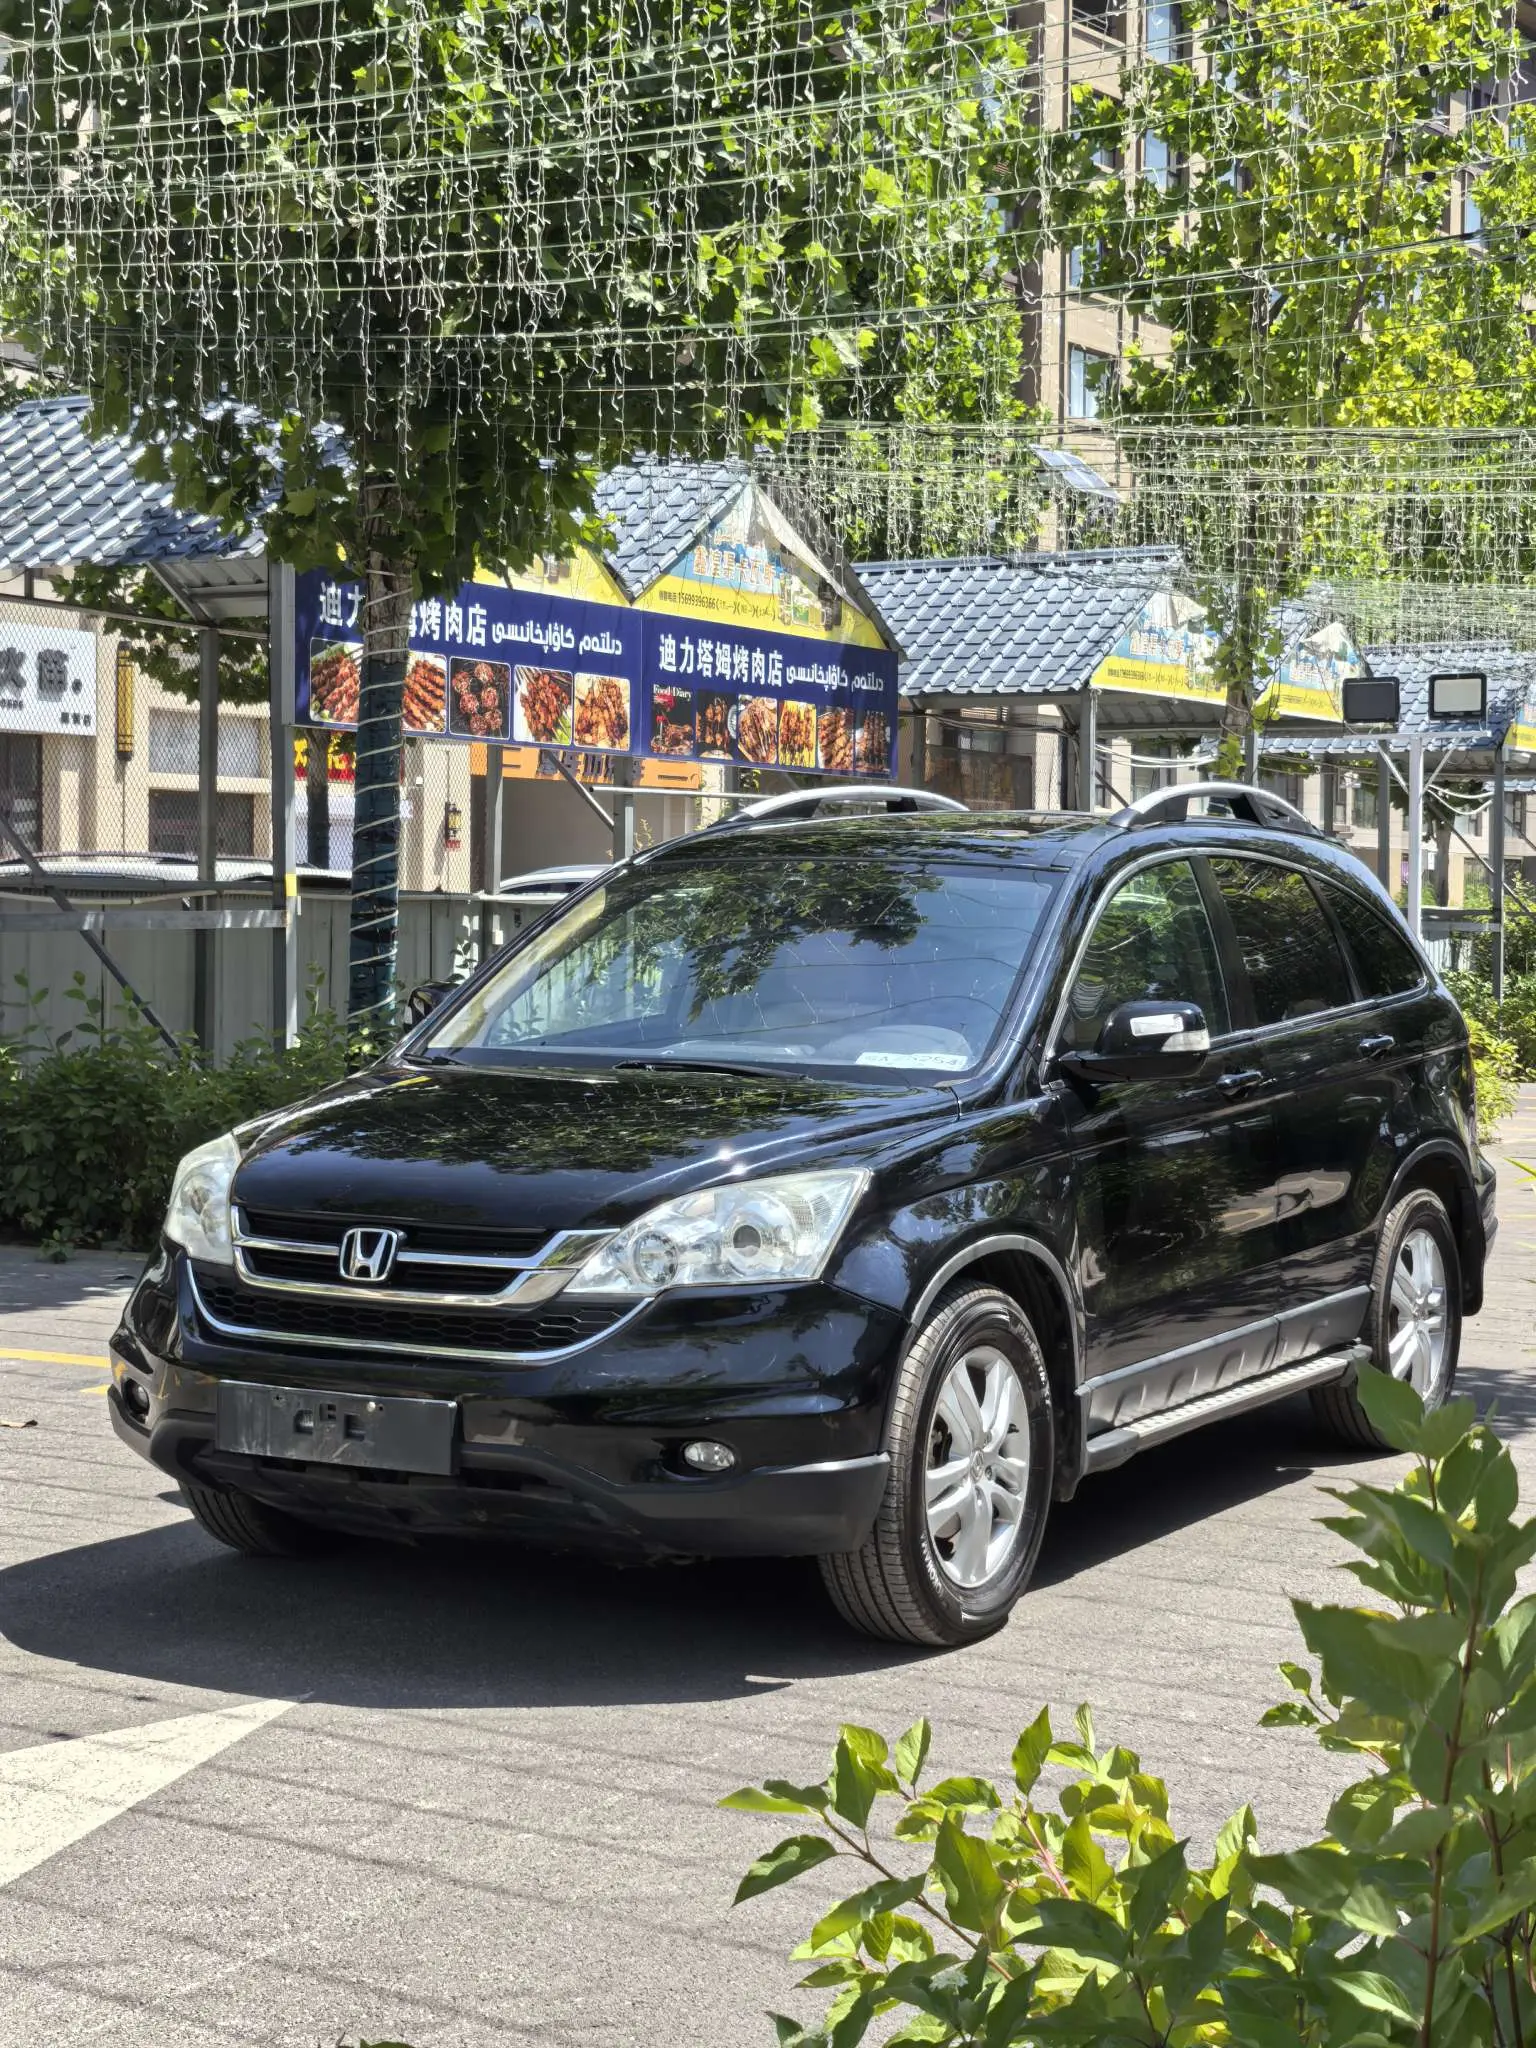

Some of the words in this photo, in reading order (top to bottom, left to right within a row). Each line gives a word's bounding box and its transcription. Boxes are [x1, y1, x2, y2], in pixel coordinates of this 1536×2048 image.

[659, 633, 783, 688] 迪力塔姆烤肉店
[653, 684, 671, 695] Food
[672, 687, 692, 702] Diary
